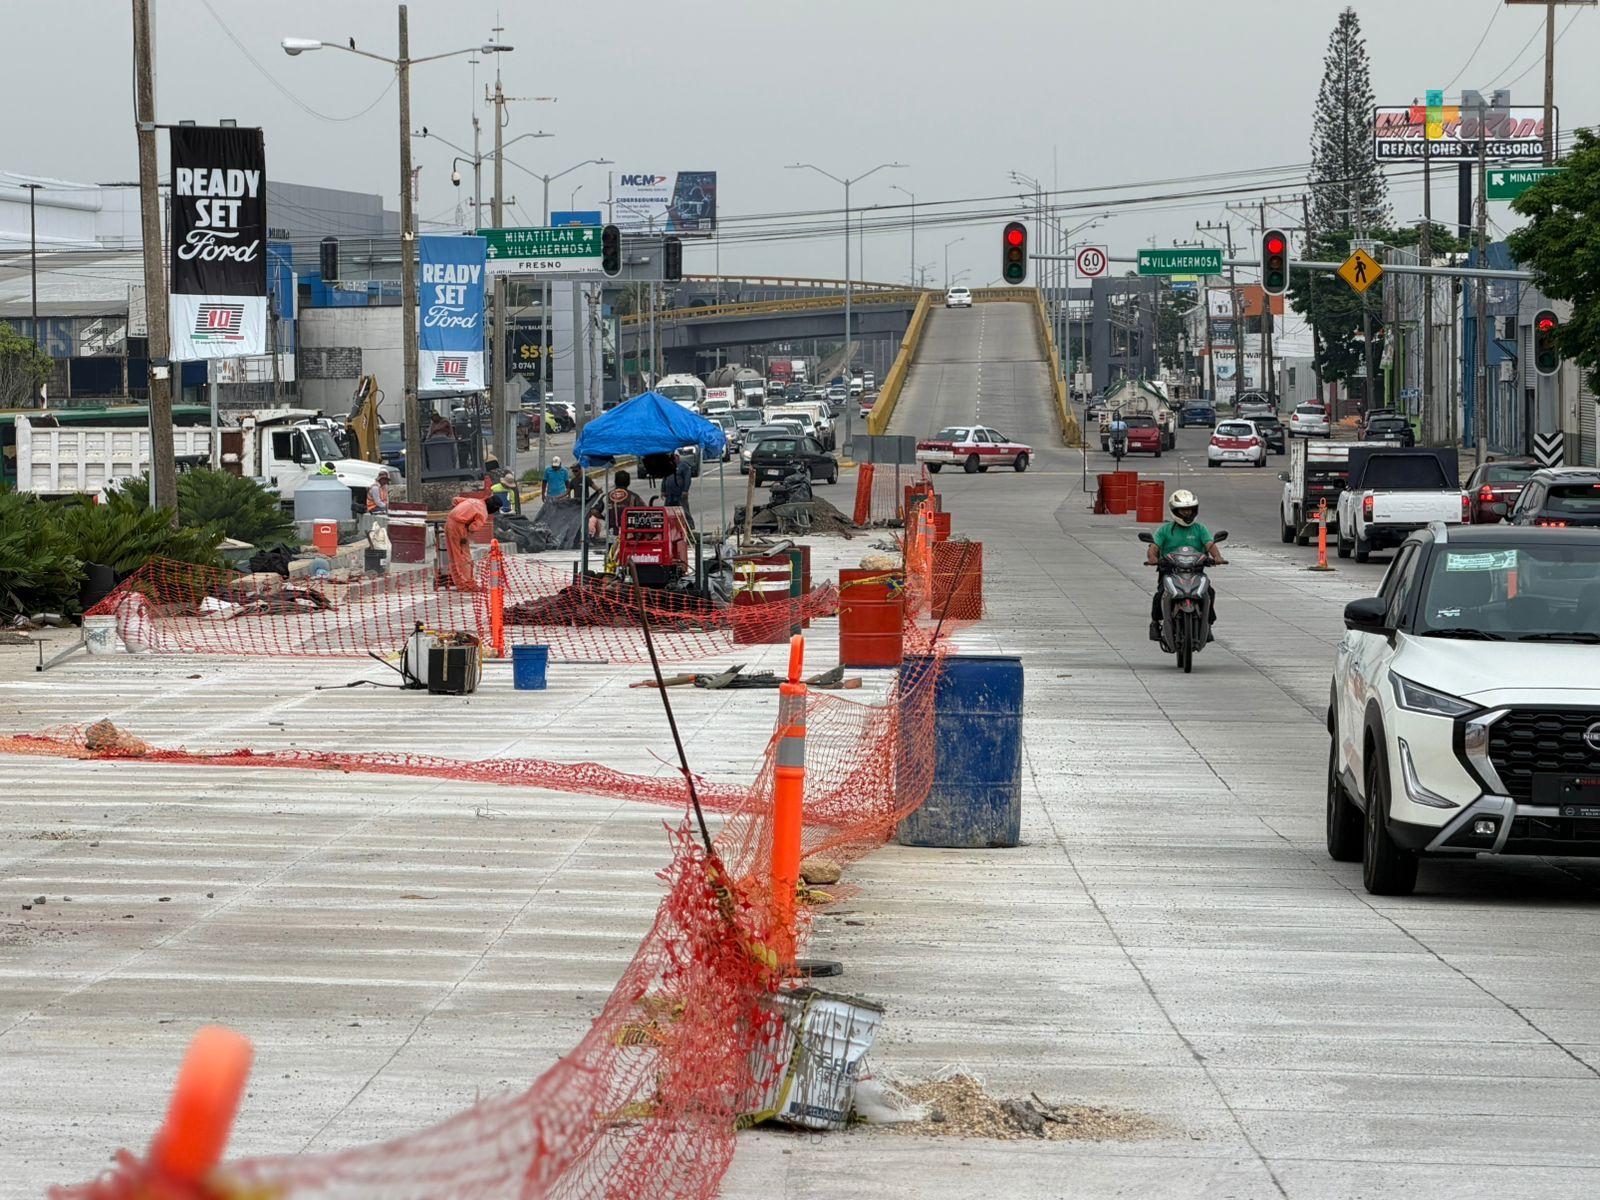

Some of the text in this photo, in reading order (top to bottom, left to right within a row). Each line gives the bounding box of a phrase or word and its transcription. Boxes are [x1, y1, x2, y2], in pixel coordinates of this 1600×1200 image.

[1467, 143, 1474, 155] Y
[176, 167, 261, 198] READY
[621, 174, 656, 186] MCM
[195, 199, 242, 228] SET
[505, 230, 574, 242] MINATITLAN
[177, 229, 260, 262] Ford
[507, 243, 593, 255] VILLAHERMOSA
[518, 261, 562, 269] FRESNO
[1083, 252, 1100, 267] 60
[1151, 257, 1218, 268] VILLAHERMOSA
[422, 263, 482, 284] READY
[435, 284, 467, 305] SET
[207, 310, 231, 328] 10
[423, 305, 479, 329] Ford
[1214, 351, 1264, 360] Tupprwar
[444, 361, 460, 374] 10
[518, 362, 536, 370] 0741
